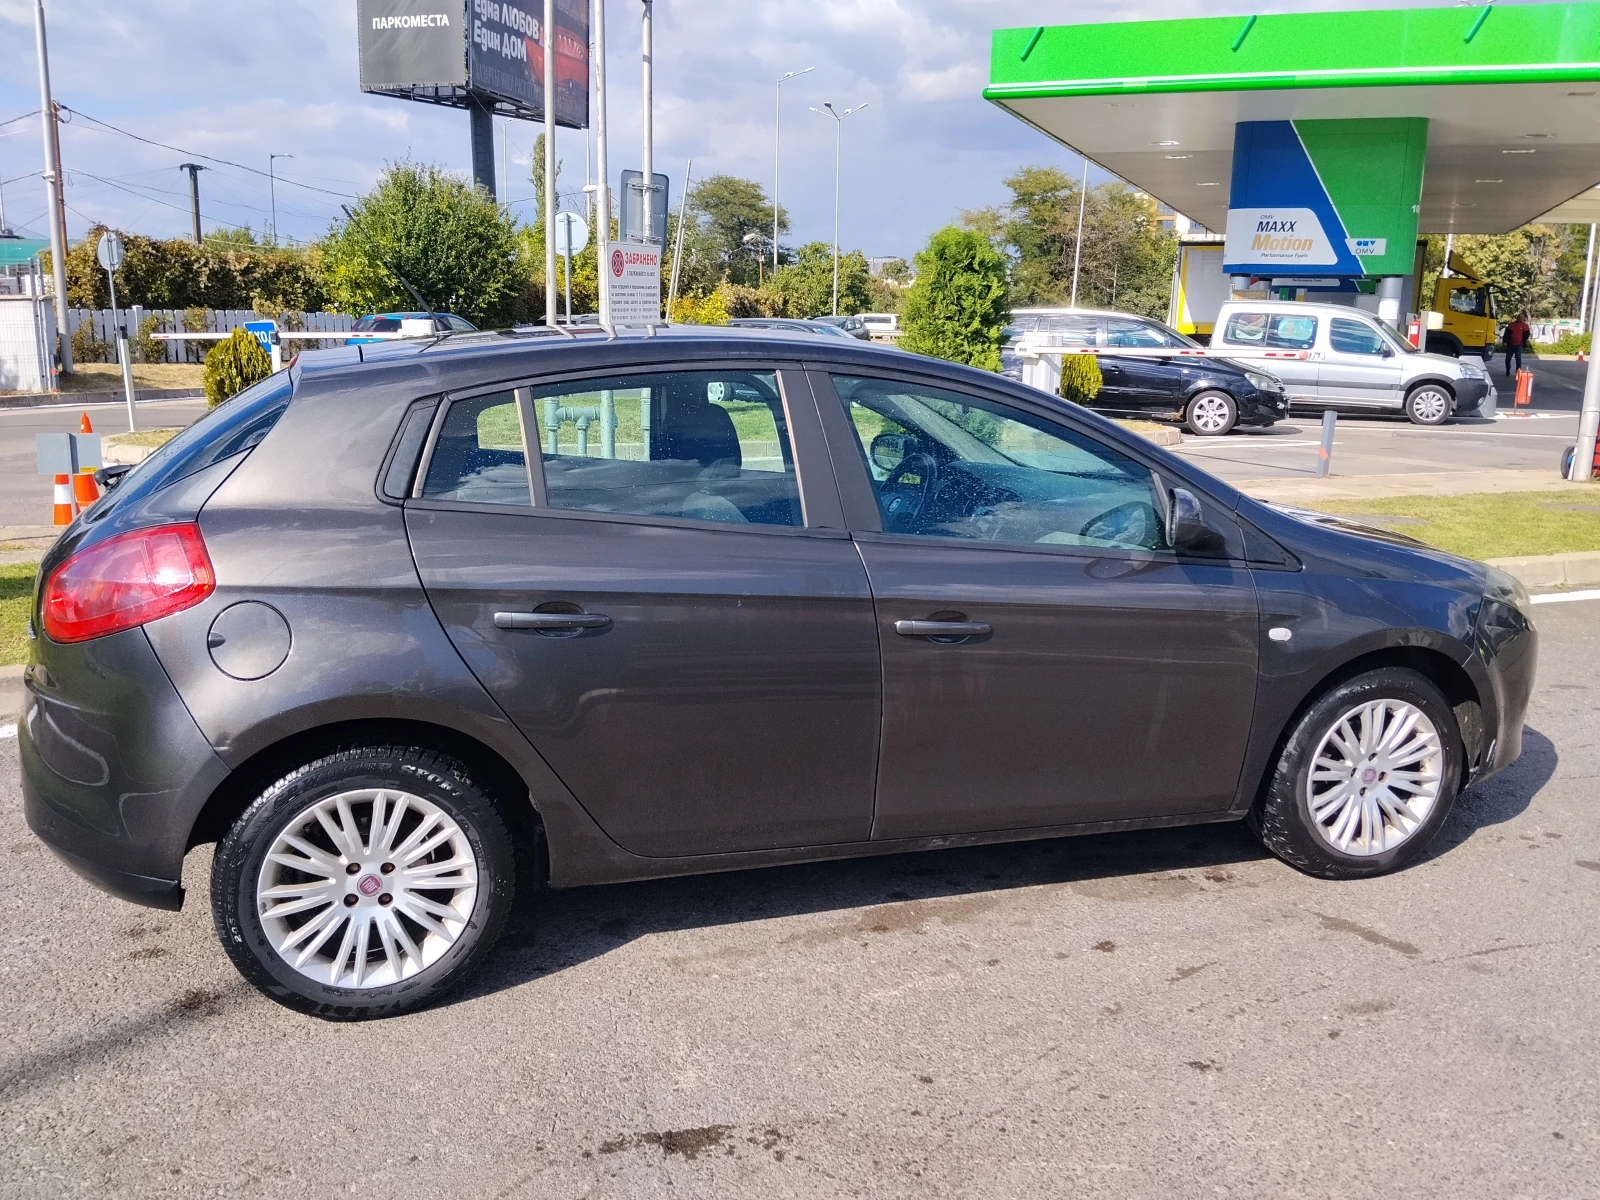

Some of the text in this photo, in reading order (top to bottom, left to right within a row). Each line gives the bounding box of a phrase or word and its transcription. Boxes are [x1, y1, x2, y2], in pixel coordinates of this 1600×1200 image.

[372, 14, 450, 30] ПАРКОМЕСТА
[501, 3, 539, 40] ЛЮБОВ
[474, 19, 501, 51] Един
[502, 32, 527, 61] ДОМ
[1256, 221, 1298, 233] MAXX
[1250, 233, 1314, 251] Motion
[625, 252, 658, 266] ЗАБРАНЕНО
